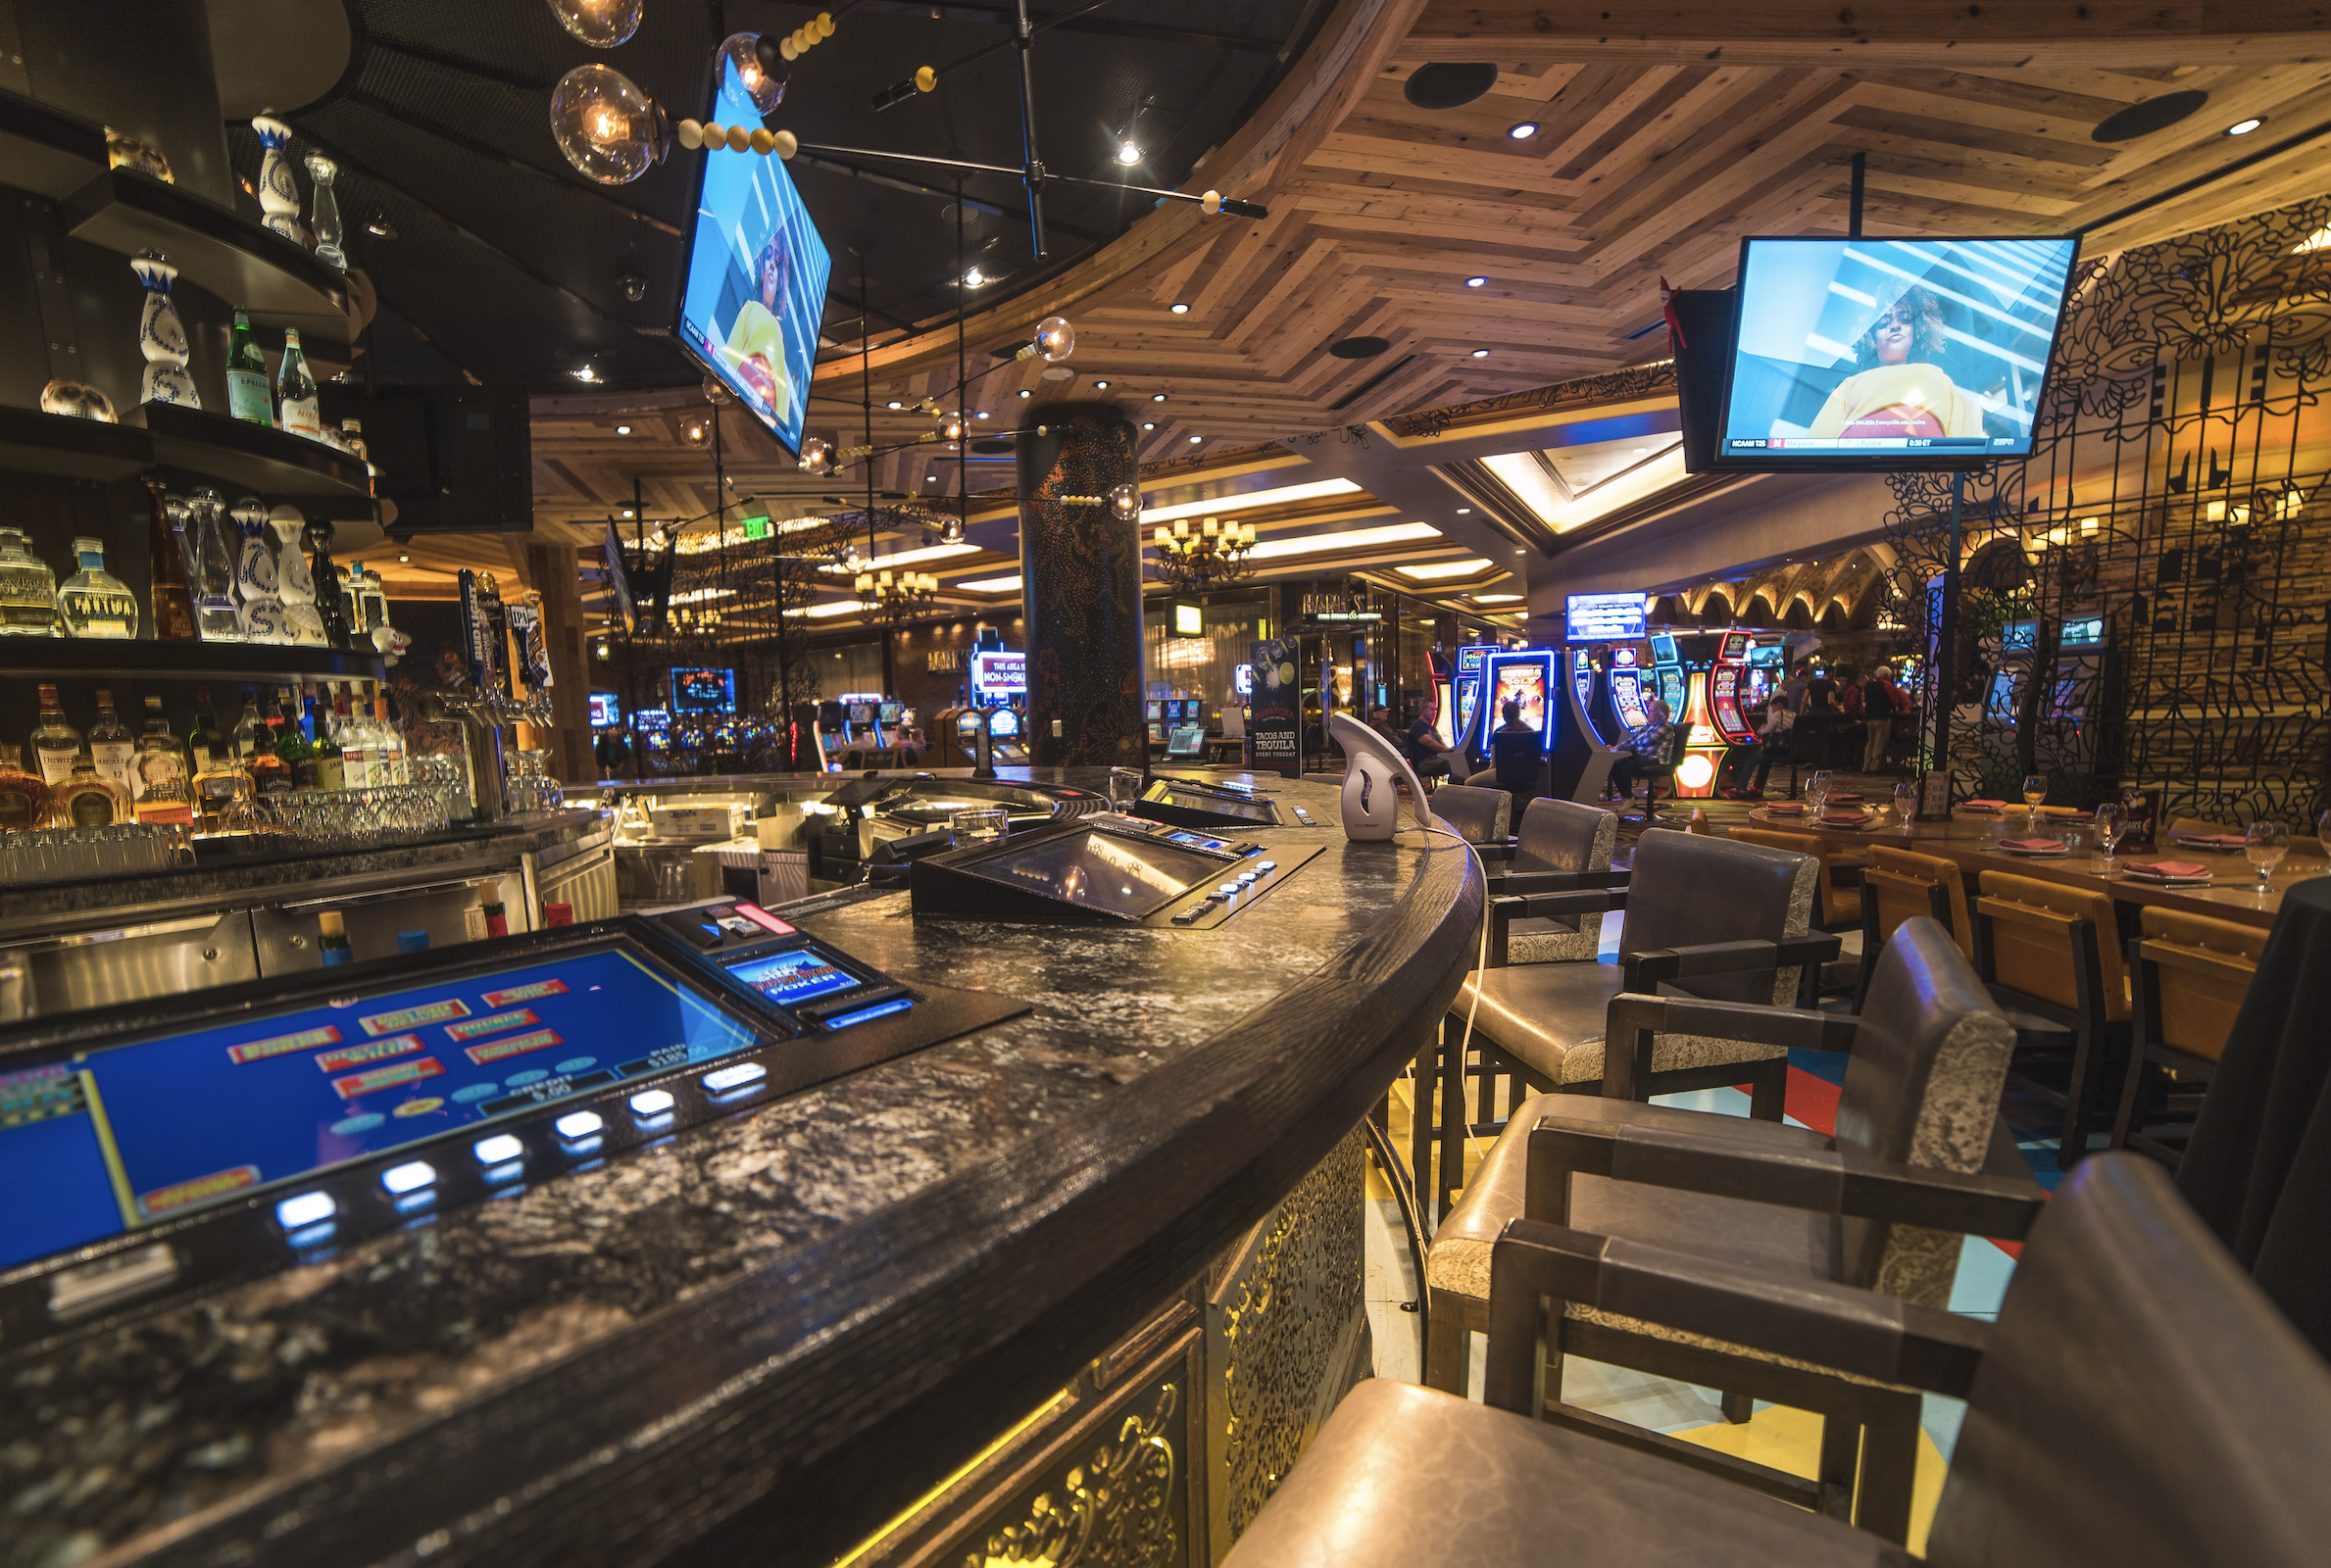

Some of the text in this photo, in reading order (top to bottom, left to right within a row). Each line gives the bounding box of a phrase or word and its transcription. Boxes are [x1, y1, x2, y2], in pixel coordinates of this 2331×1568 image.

[468, 584, 483, 662] BUD LIGHT
[513, 611, 527, 624] IPA
[1007, 662, 1020, 671] AREA
[984, 671, 1026, 682] NON-SMOKI
[1256, 731, 1296, 740] TACOS AND
[1256, 740, 1296, 751] TEQUILA
[113, 769, 124, 779] 12
[650, 1043, 687, 1057] PAID
[509, 1074, 573, 1097] CREDIT
